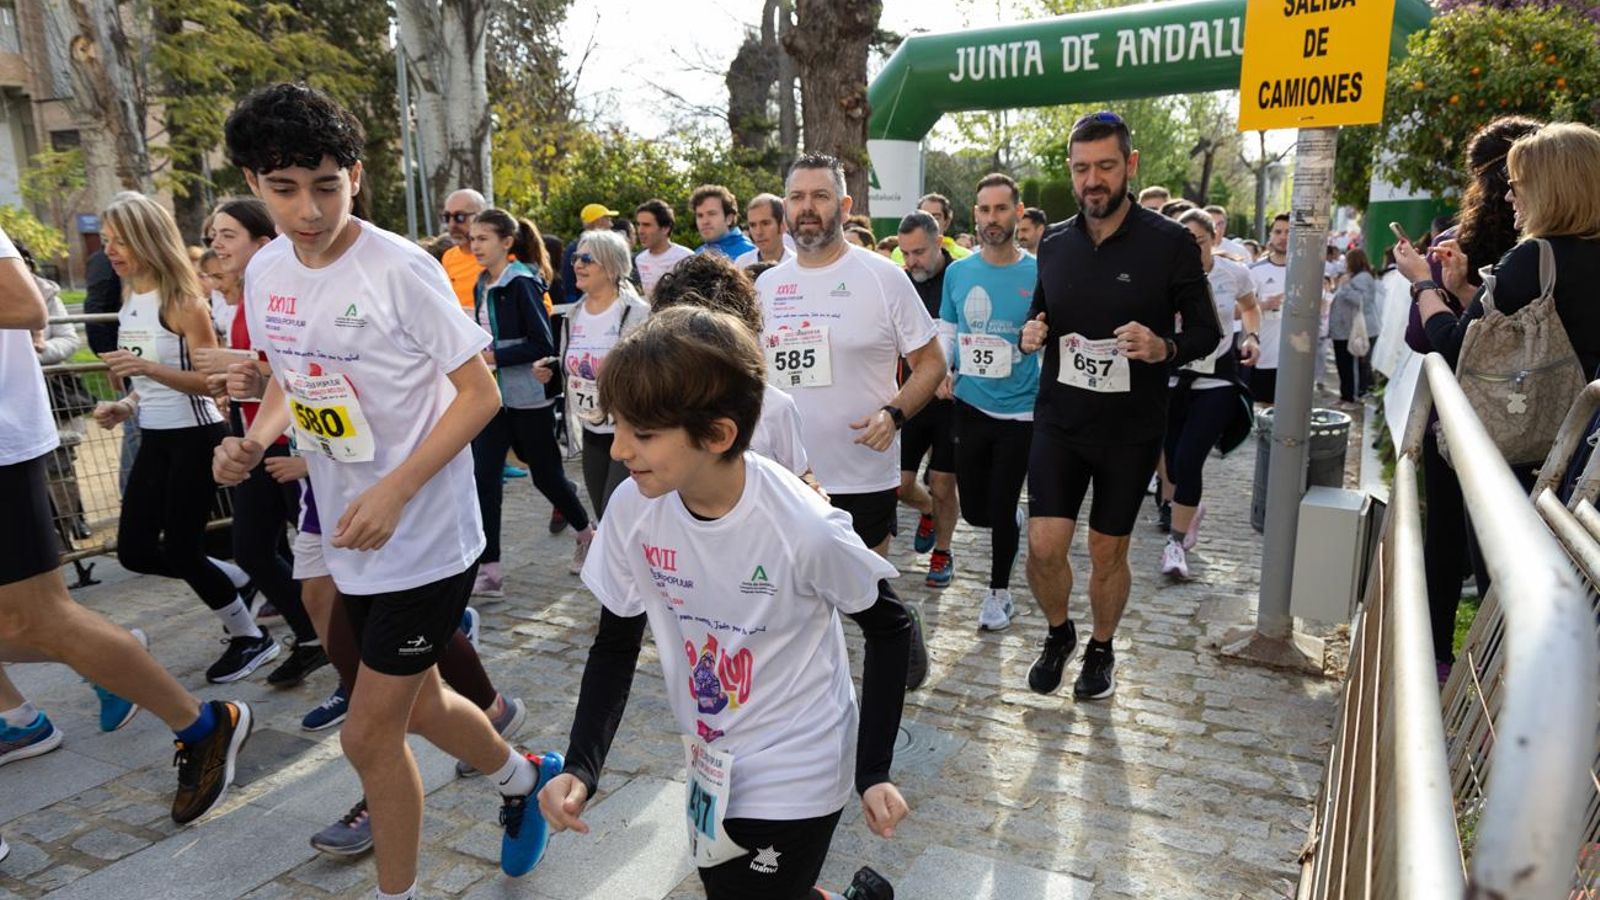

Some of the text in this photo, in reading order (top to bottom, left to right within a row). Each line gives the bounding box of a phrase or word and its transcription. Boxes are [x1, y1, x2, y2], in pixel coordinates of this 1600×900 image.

[1283, 0, 1356, 17] SAL
[1303, 27, 1329, 58] DE
[949, 39, 1044, 82] JUNTA
[1061, 33, 1100, 73] DE
[1258, 72, 1363, 110] CAMIONES
[775, 348, 815, 371] 585
[973, 349, 994, 364] 35
[1074, 353, 1113, 377] 657
[576, 392, 600, 409] 71
[295, 402, 345, 437] 580
